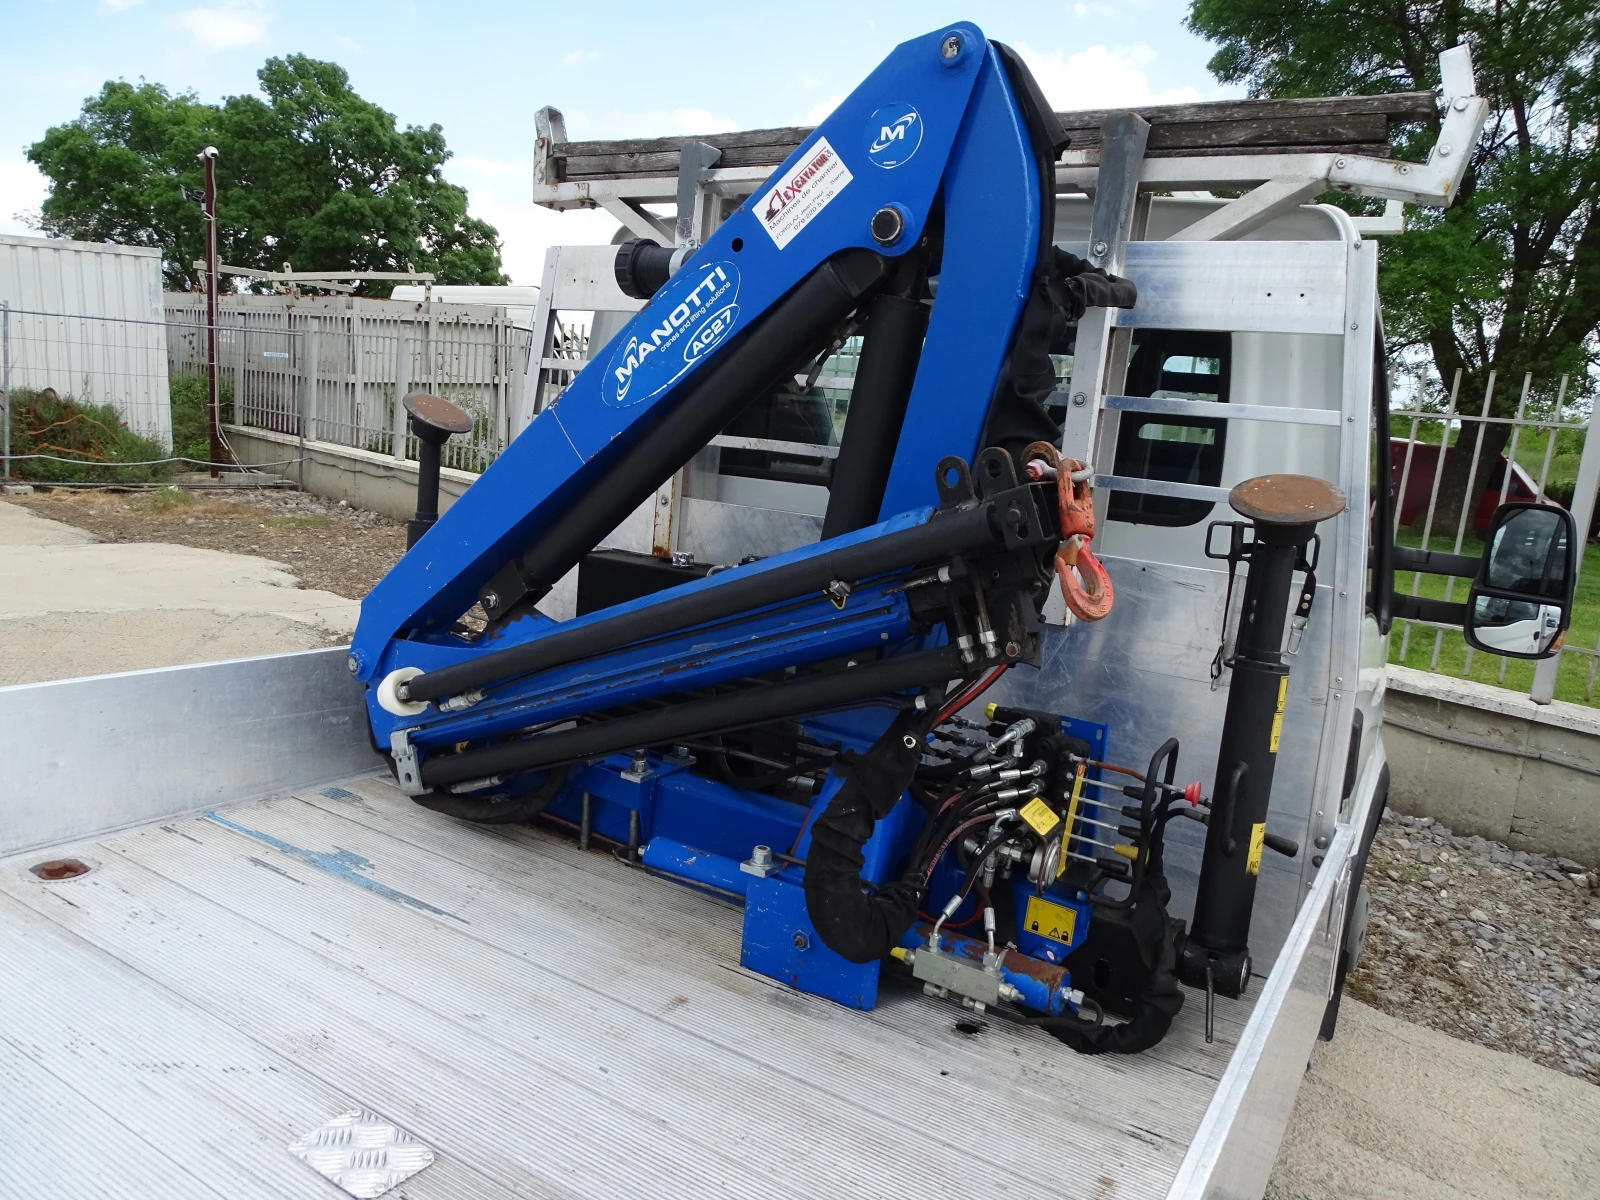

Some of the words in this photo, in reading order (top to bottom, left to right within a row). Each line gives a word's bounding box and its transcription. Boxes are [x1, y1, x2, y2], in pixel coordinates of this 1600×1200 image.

[881, 125, 905, 141] M
[769, 198, 801, 231] Machines
[801, 187, 811, 199] de
[811, 160, 838, 189] chantier
[614, 266, 727, 383] MANOTTI
[660, 332, 680, 353] cranes
[679, 320, 690, 333] and
[689, 306, 707, 323] lifting
[705, 281, 731, 308] solutions
[692, 309, 731, 355] AC27
